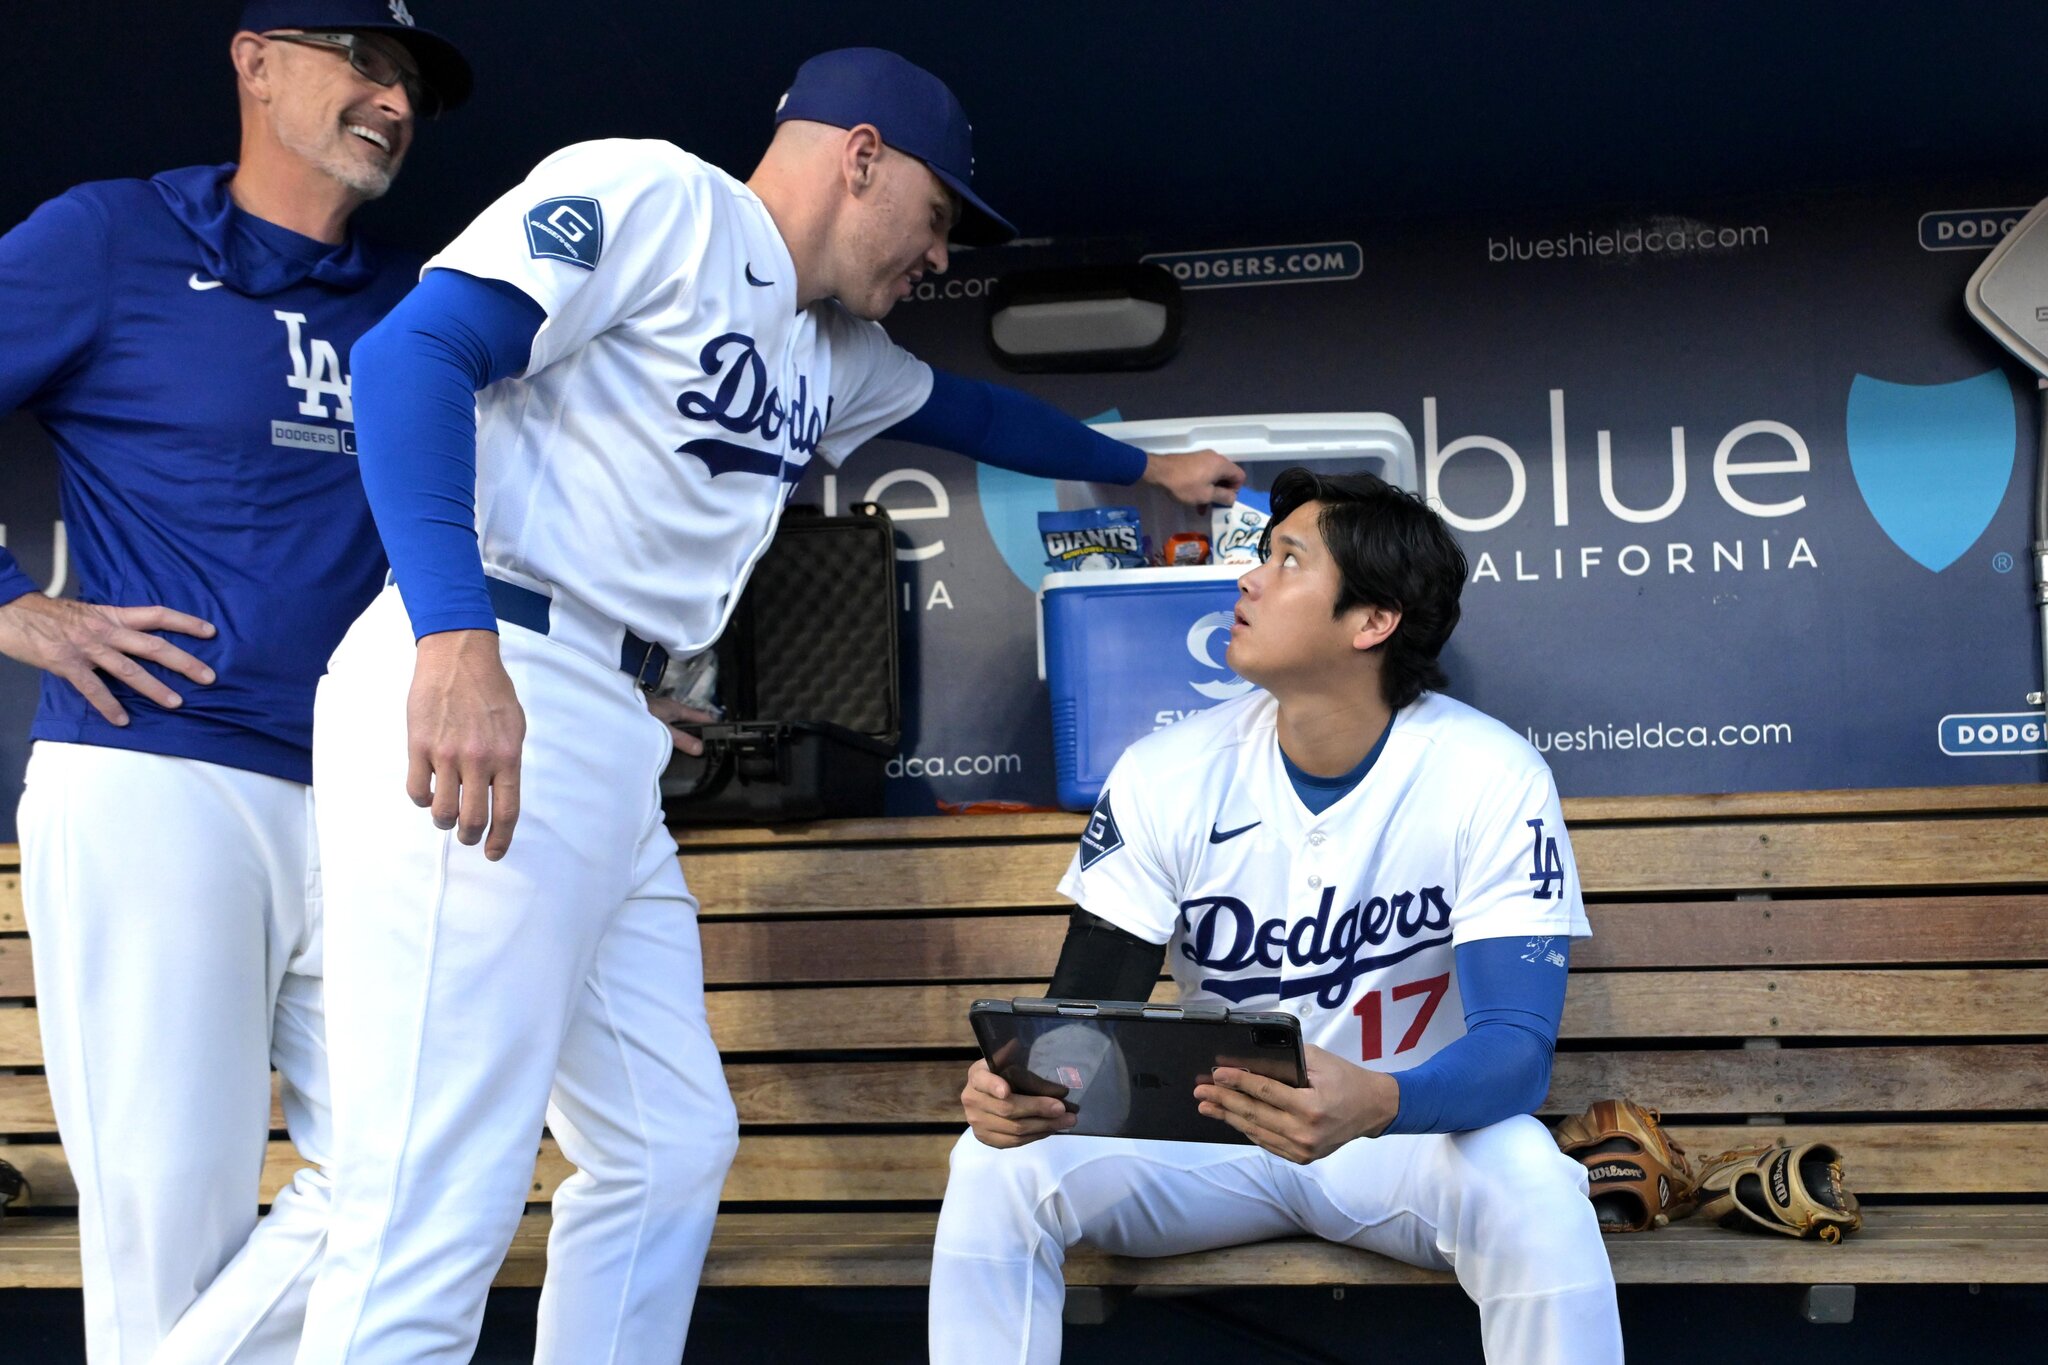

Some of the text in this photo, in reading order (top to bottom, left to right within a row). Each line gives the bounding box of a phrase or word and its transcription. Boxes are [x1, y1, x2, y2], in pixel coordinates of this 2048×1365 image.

[1488, 224, 1770, 262] blueshieldca.com
[1937, 217, 2019, 240] DODG
[1159, 251, 1345, 280] ODGERS.COM
[275, 427, 336, 445] DODGERS
[1422, 388, 1812, 533] blue
[1046, 526, 1138, 557] GIANTS
[1471, 537, 1819, 583] ALIFORNIA
[1527, 721, 1792, 753] lueshieldca.com
[885, 753, 1022, 779] dca.com
[1180, 885, 1453, 1010] Dodgers
[1353, 971, 1450, 1062] 17
[1589, 1164, 1642, 1181] Wilson
[1773, 1152, 1788, 1203] Wilson
